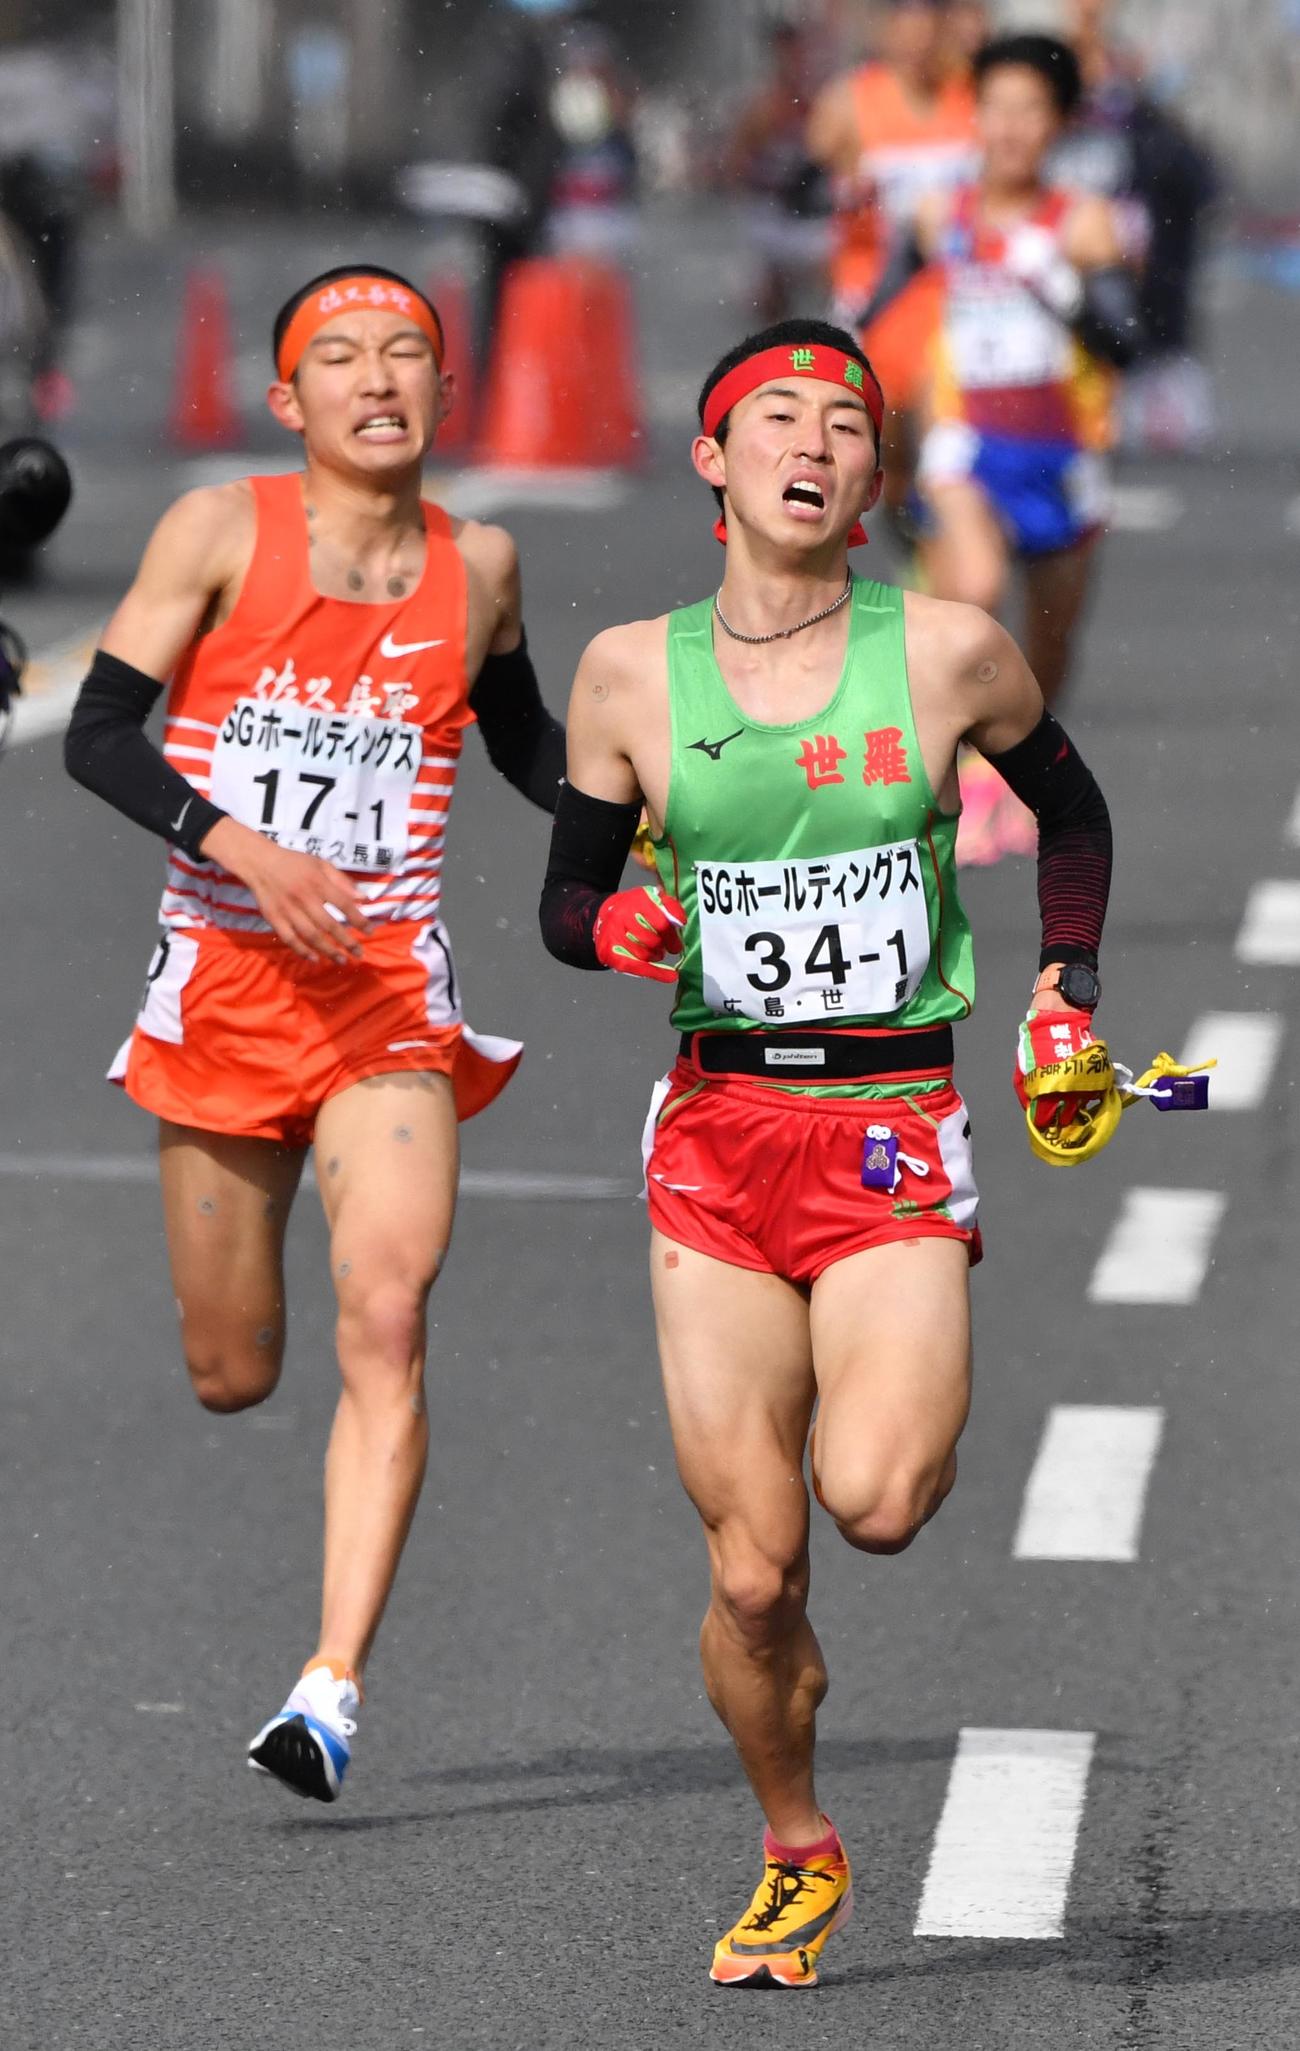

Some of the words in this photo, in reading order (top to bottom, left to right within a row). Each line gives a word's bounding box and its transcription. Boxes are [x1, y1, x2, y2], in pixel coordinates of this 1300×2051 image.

[223, 703, 415, 772] SGホールディングス
[795, 726, 912, 791] 世羅
[252, 768, 385, 842] 17-1
[700, 848, 920, 917] SGホールディングス
[744, 923, 908, 993] 34-1
